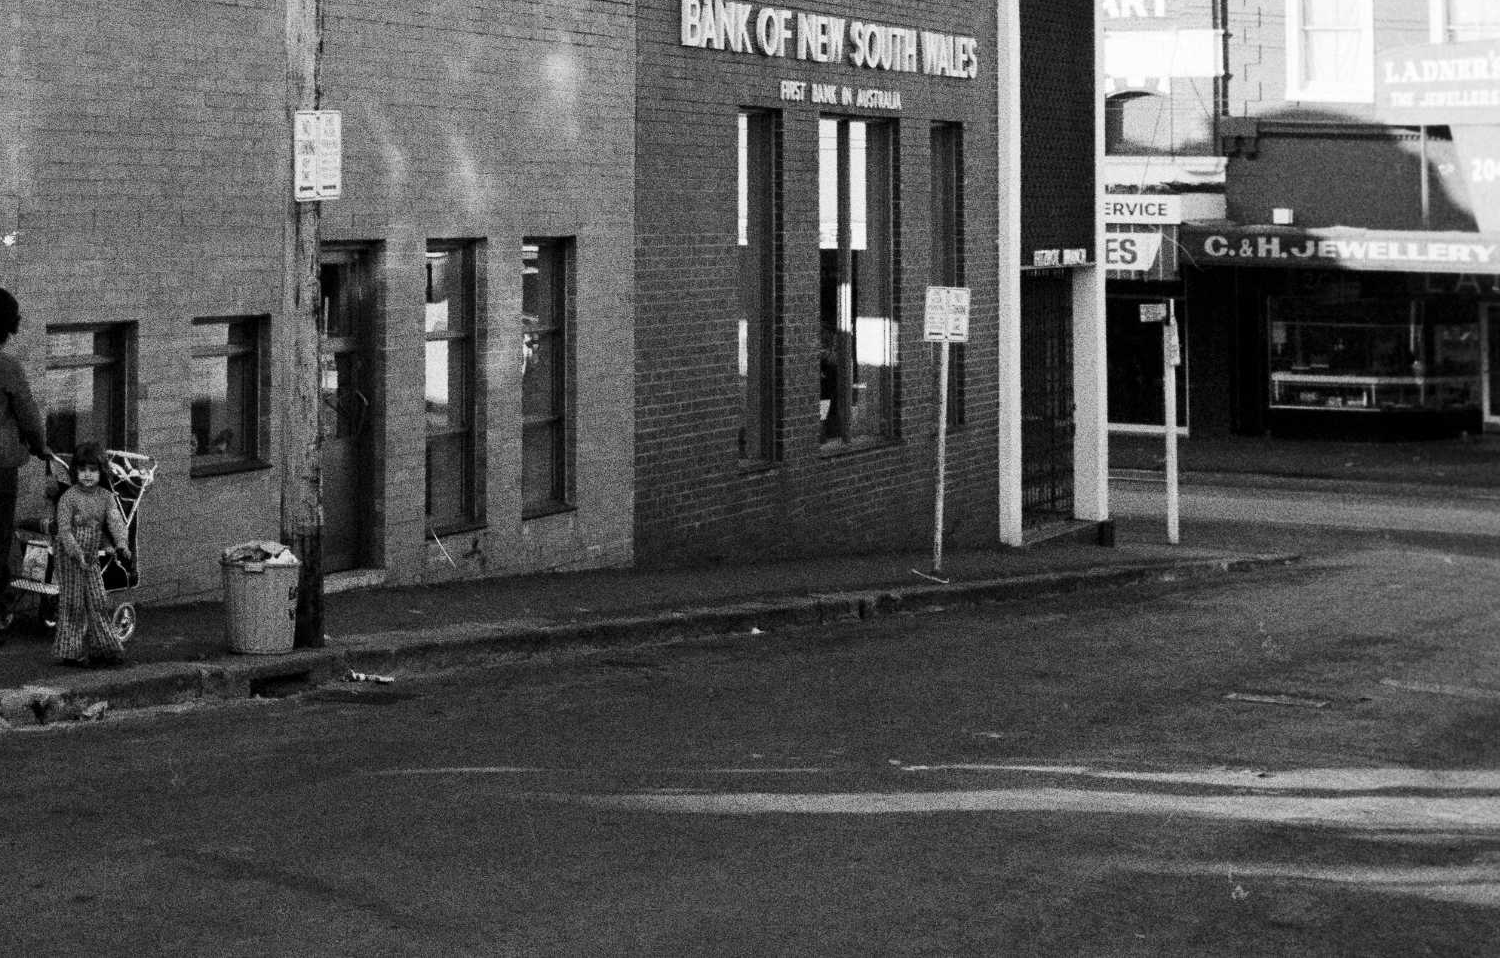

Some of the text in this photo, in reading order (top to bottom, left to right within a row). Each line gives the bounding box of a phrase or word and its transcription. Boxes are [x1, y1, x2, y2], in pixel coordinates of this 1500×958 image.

[755, 7, 792, 57] OF
[797, 12, 846, 63] NEW
[850, 21, 917, 73] SOUTH
[920, 30, 978, 79] WALES
[780, 80, 901, 110] FIRST BANK IN AUSTRALIA
[1105, 238, 1137, 264] ES
[1291, 239, 1499, 263] JEWELLERY
